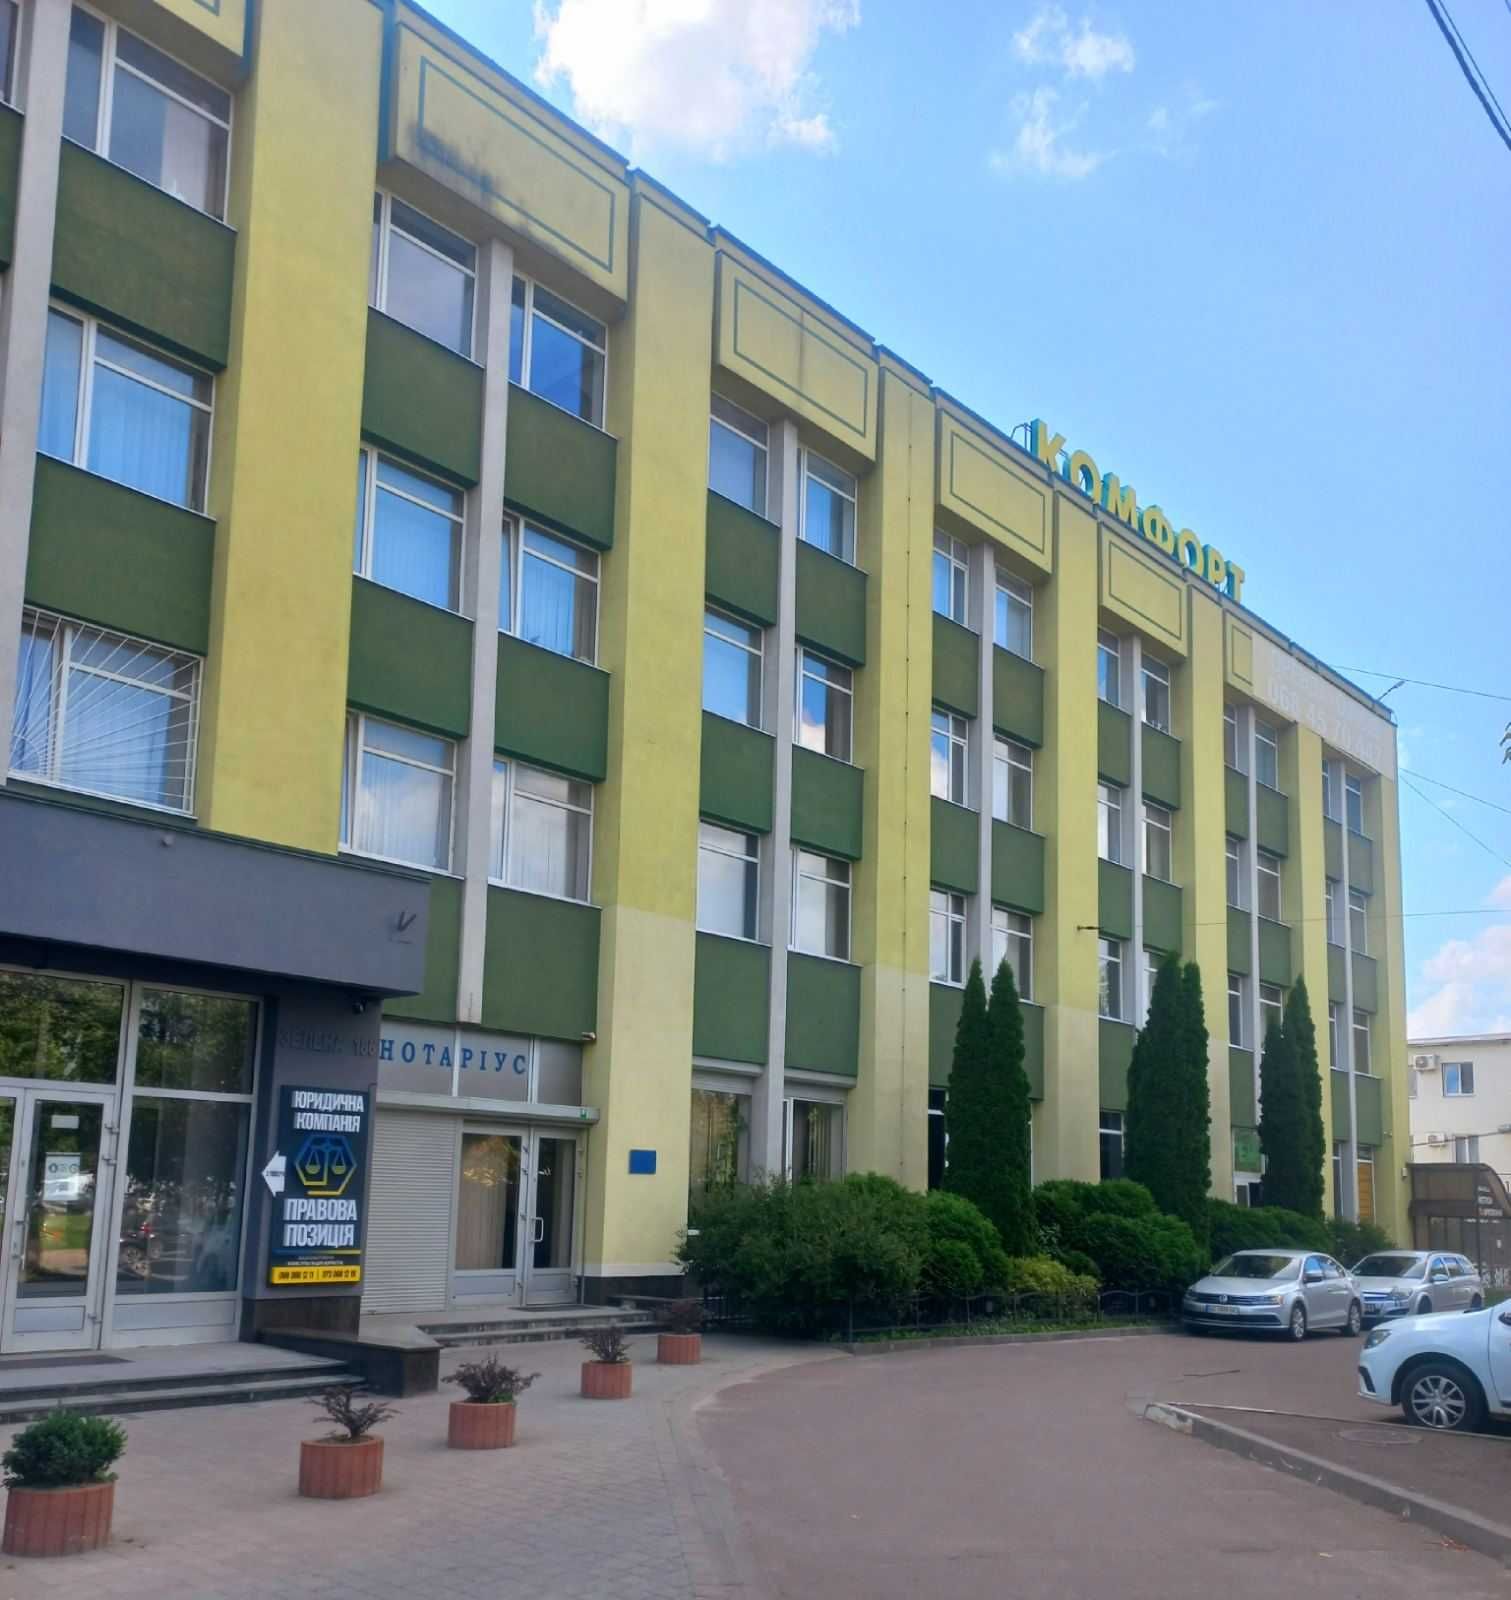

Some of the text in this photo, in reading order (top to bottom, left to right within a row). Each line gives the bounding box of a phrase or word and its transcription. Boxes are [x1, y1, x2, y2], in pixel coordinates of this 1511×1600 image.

[1030, 418, 1245, 604] КОМФОРТ
[379, 1039, 526, 1074] НОТАРІУС
[292, 1091, 364, 1112] ЮРИДИЧНА
[294, 1112, 360, 1132] КОМПАНІЯ
[284, 1198, 357, 1221] ПРАВОВА
[284, 1224, 354, 1248] ПОЗИЦІЯ
